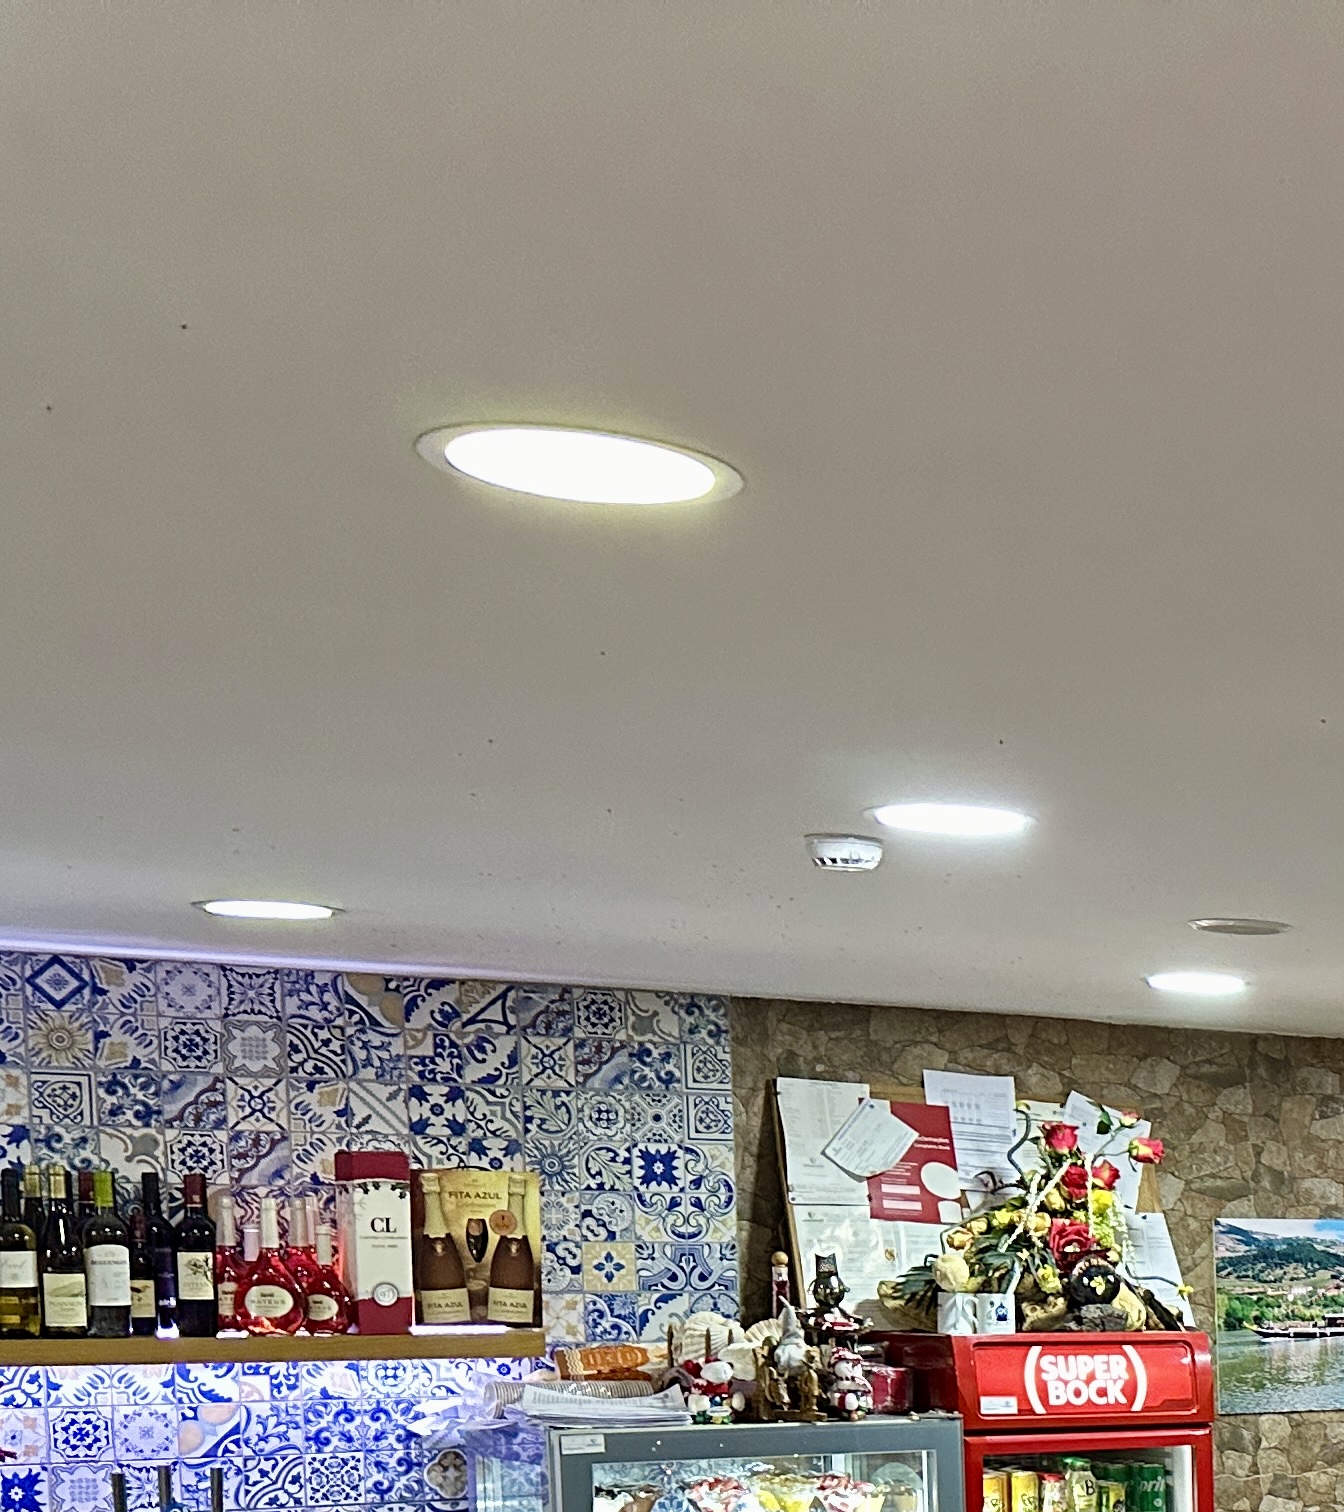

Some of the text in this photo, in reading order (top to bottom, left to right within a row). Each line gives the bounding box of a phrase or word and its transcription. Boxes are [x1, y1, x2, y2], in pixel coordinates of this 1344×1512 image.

[474, 1191, 503, 1200] AZUL
[370, 1217, 397, 1233] CL
[1039, 1354, 1129, 1381] SUPER
[1046, 1378, 1128, 1406] BOCK
